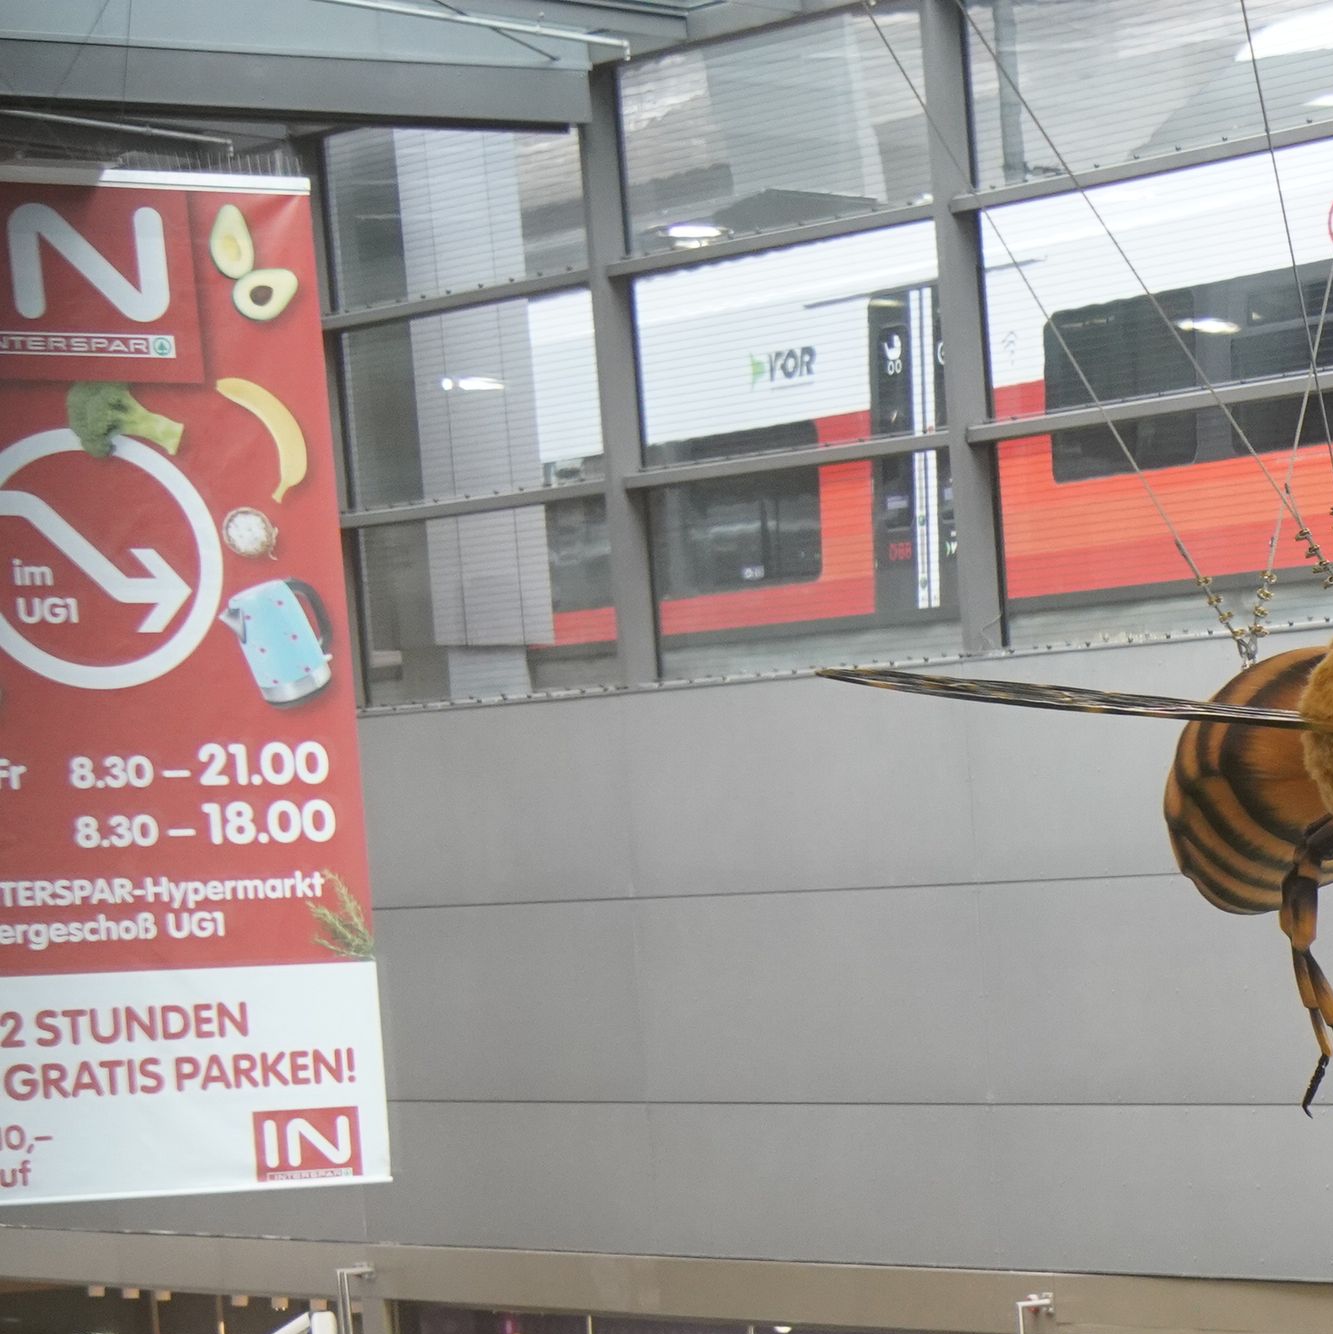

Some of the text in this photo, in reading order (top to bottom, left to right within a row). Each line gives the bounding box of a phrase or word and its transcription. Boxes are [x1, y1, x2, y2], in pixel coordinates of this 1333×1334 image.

[13, 558, 53, 586] im
[17, 597, 78, 624] UG1
[70, 756, 154, 788] 8.30
[198, 741, 329, 786] 21.00
[74, 815, 159, 848] 8.30
[201, 799, 336, 845] 18.00
[0, 911, 226, 950] ergeschoß UG1
[0, 1001, 249, 1047] 2 STUNDEN
[3, 1047, 356, 1101] GRATIS PARKEN!
[263, 1115, 352, 1169] IN
